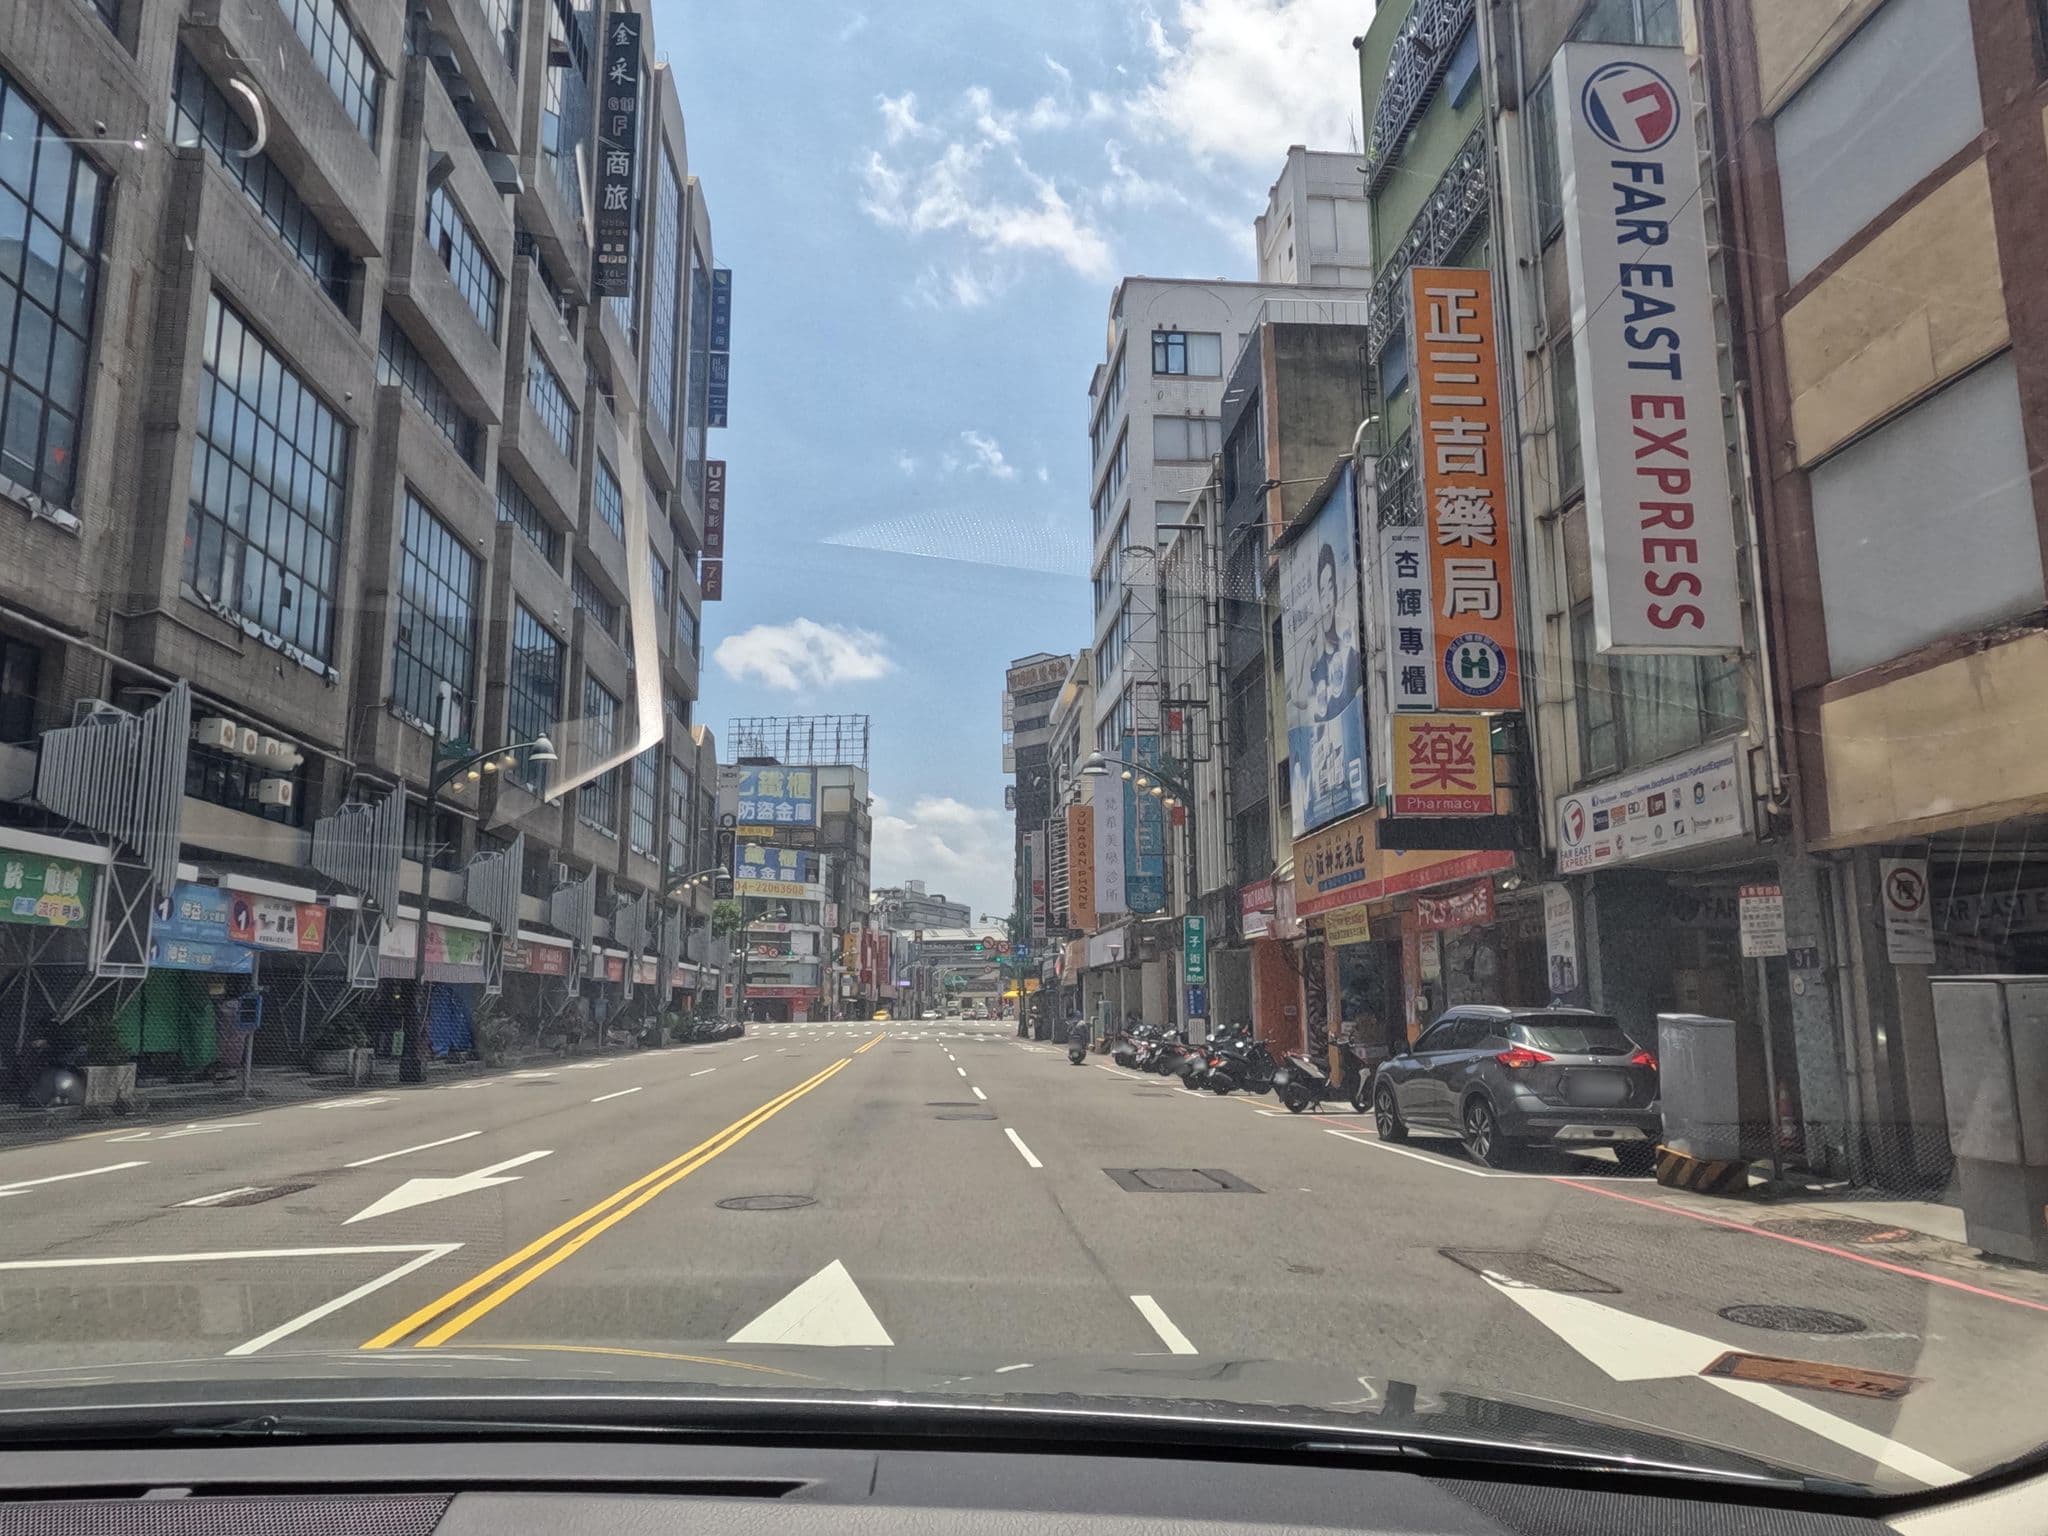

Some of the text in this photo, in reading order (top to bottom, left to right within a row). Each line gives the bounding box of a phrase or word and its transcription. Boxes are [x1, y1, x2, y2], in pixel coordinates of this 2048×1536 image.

[604, 150, 630, 211] 商旅
[1610, 160, 1706, 631] FAR EAST EXPRESS
[1424, 287, 1500, 621] 正三吉藥局
[1395, 551, 1427, 696] 杏輝專櫃
[1408, 722, 1477, 790] 藥
[1407, 797, 1480, 812] Pharmacy
[1560, 848, 1574, 859] FAR
[1575, 845, 1592, 856] EAST
[1560, 855, 1592, 868] EXPRESS
[872, 903, 897, 913] KFC
